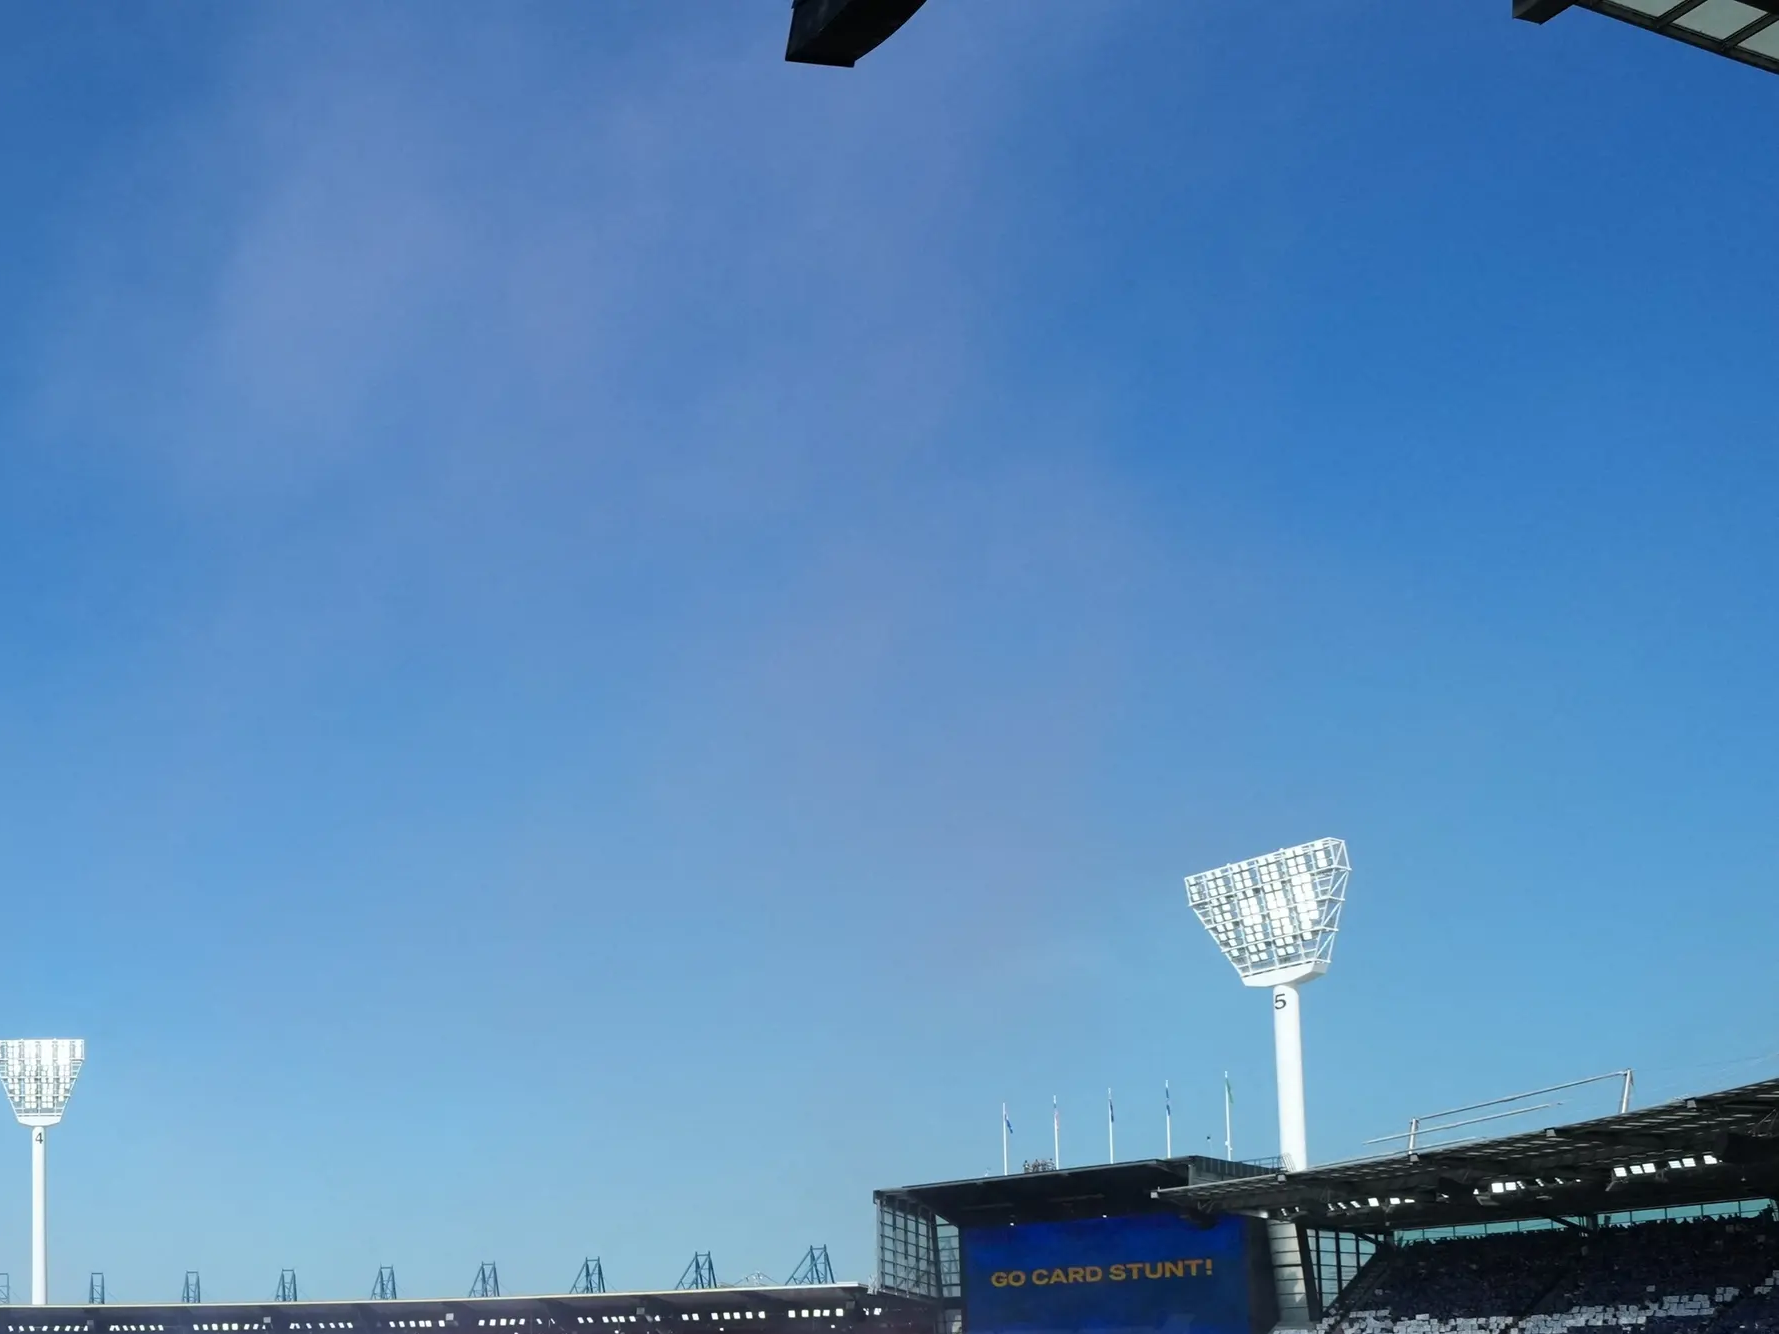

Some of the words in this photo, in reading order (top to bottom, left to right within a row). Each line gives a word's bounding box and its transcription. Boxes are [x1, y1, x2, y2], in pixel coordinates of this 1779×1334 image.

[1274, 993, 1287, 1010] 5
[991, 1271, 1026, 1288] GO
[1032, 1266, 1102, 1285] CARD
[1109, 1259, 1213, 1281] STUNT!
